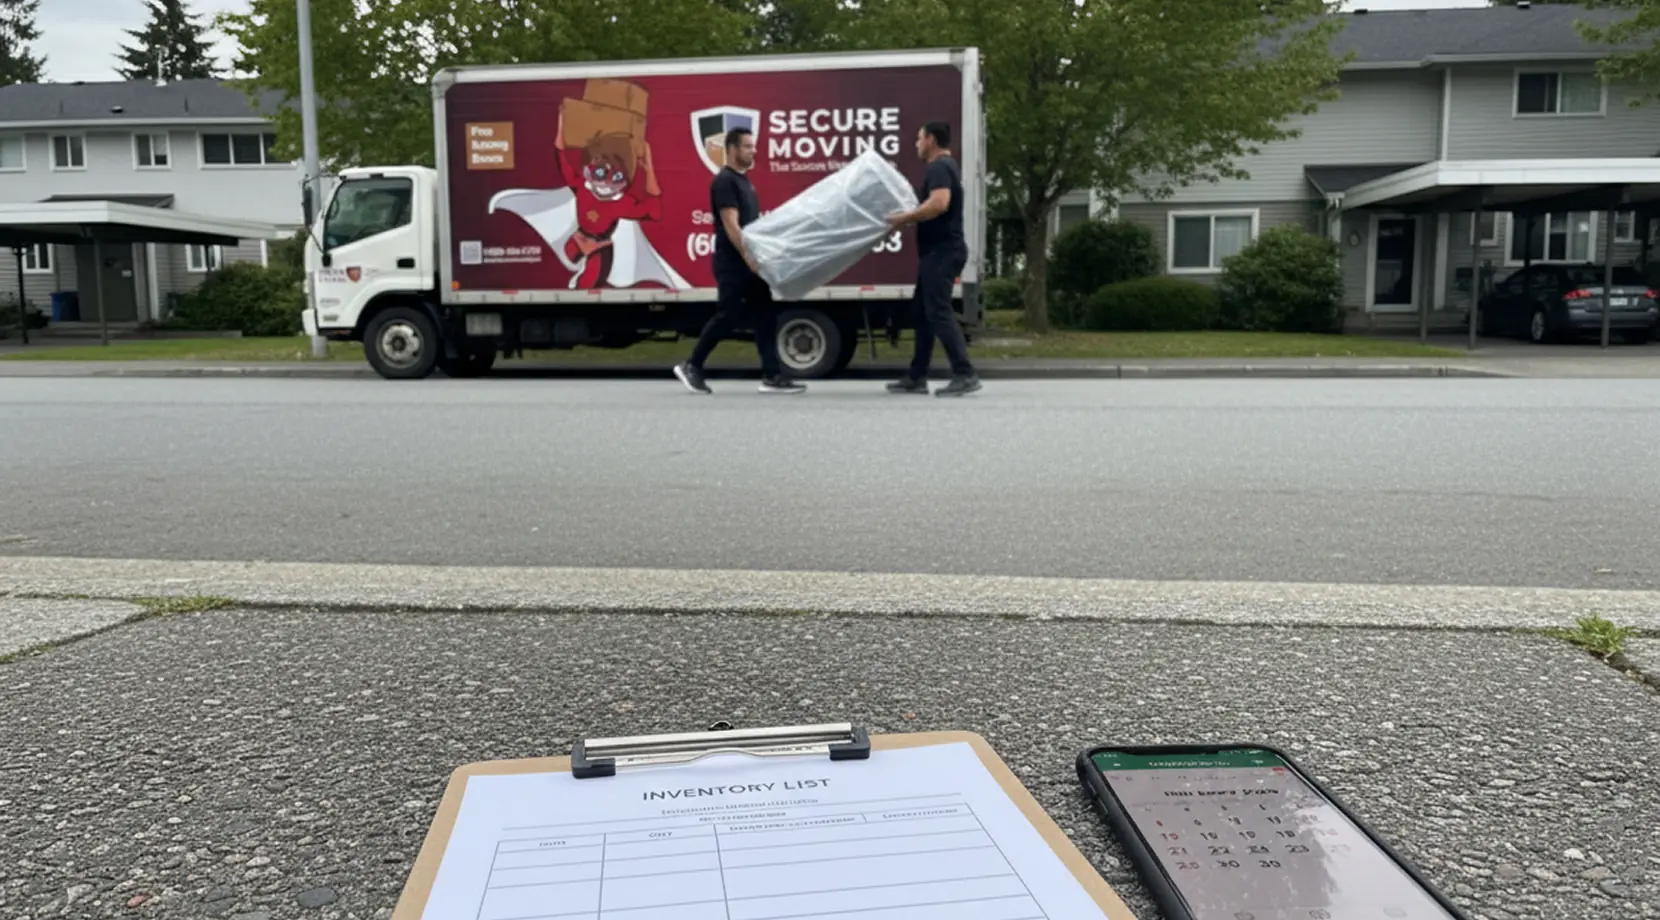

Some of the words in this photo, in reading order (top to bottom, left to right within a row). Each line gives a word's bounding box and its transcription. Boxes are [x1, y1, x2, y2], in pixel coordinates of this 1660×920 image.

[768, 107, 900, 134] SECURE
[768, 134, 900, 159] MOVING
[643, 782, 776, 801] INVENTORY
[783, 777, 831, 791] LIST
